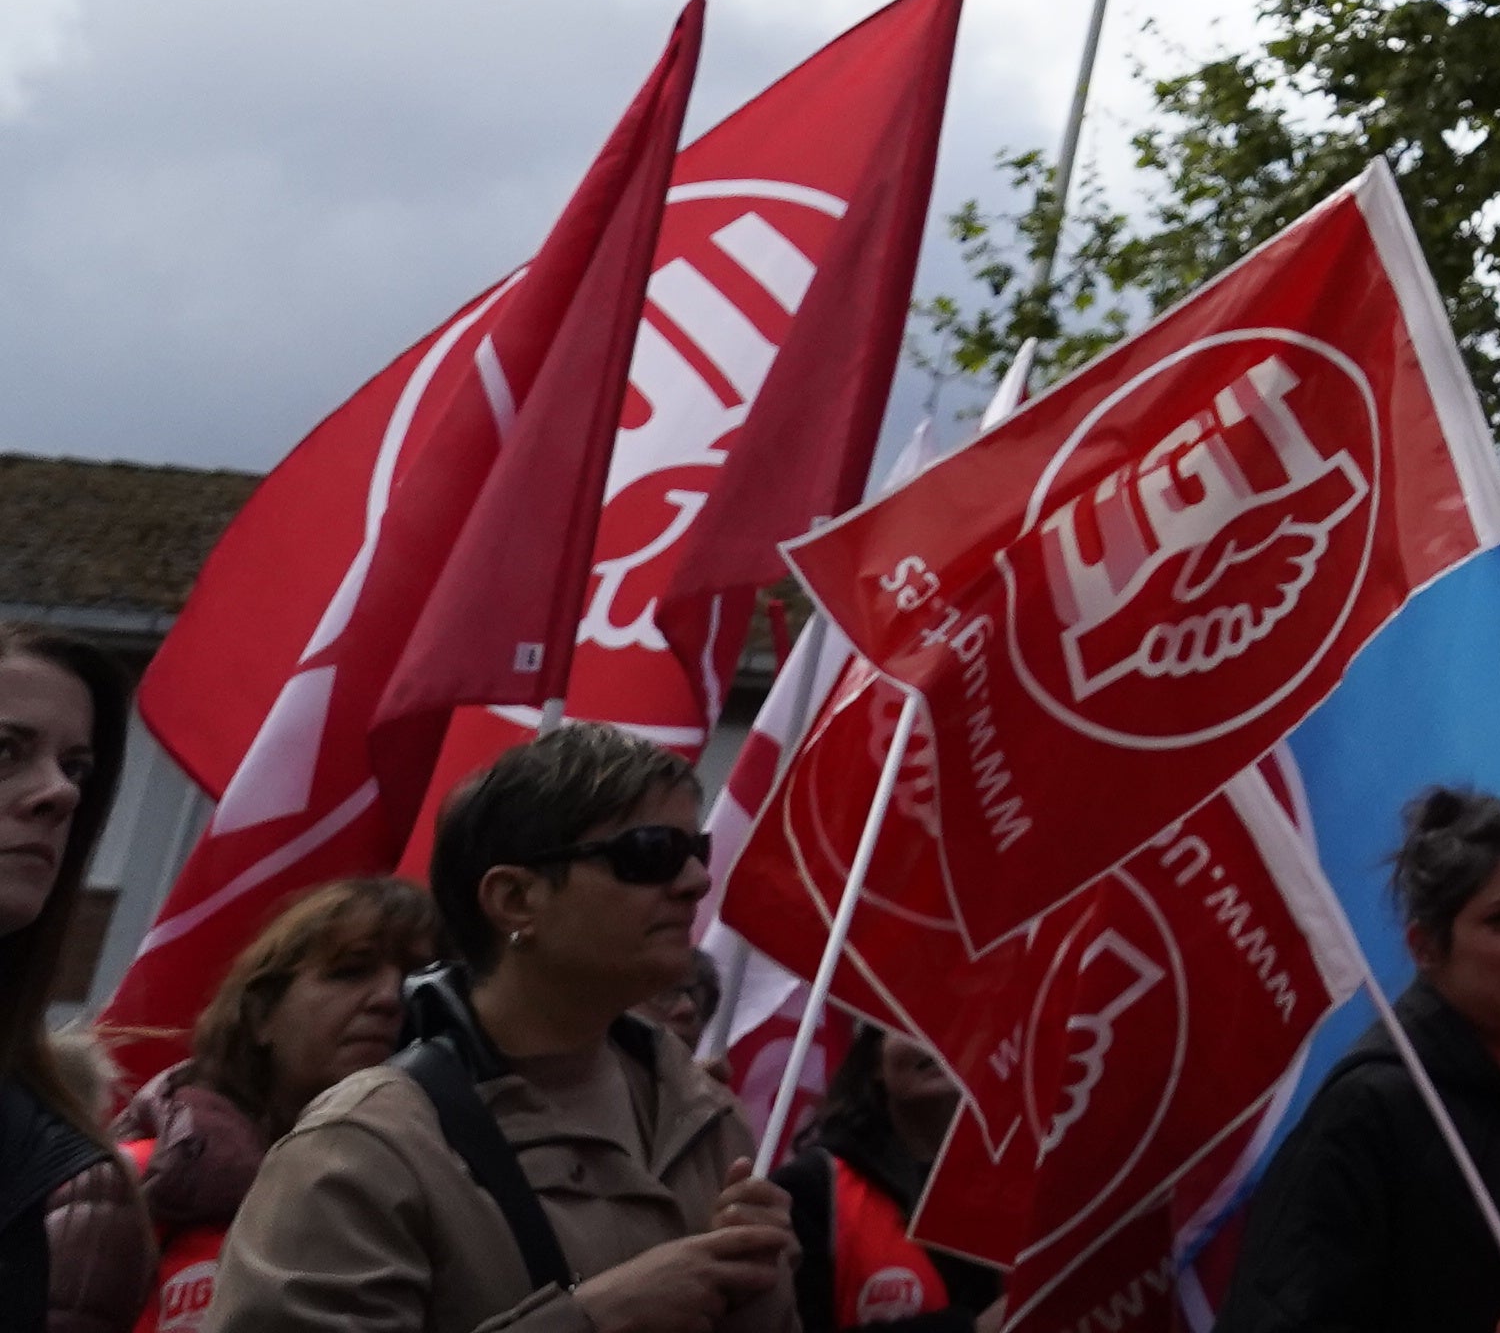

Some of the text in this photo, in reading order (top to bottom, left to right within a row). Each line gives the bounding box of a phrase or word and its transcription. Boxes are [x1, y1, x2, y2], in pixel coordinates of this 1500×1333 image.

[1041, 355, 1302, 631] UGT
[880, 554, 1034, 855] www.ugt.es
[164, 1276, 213, 1319] UG
